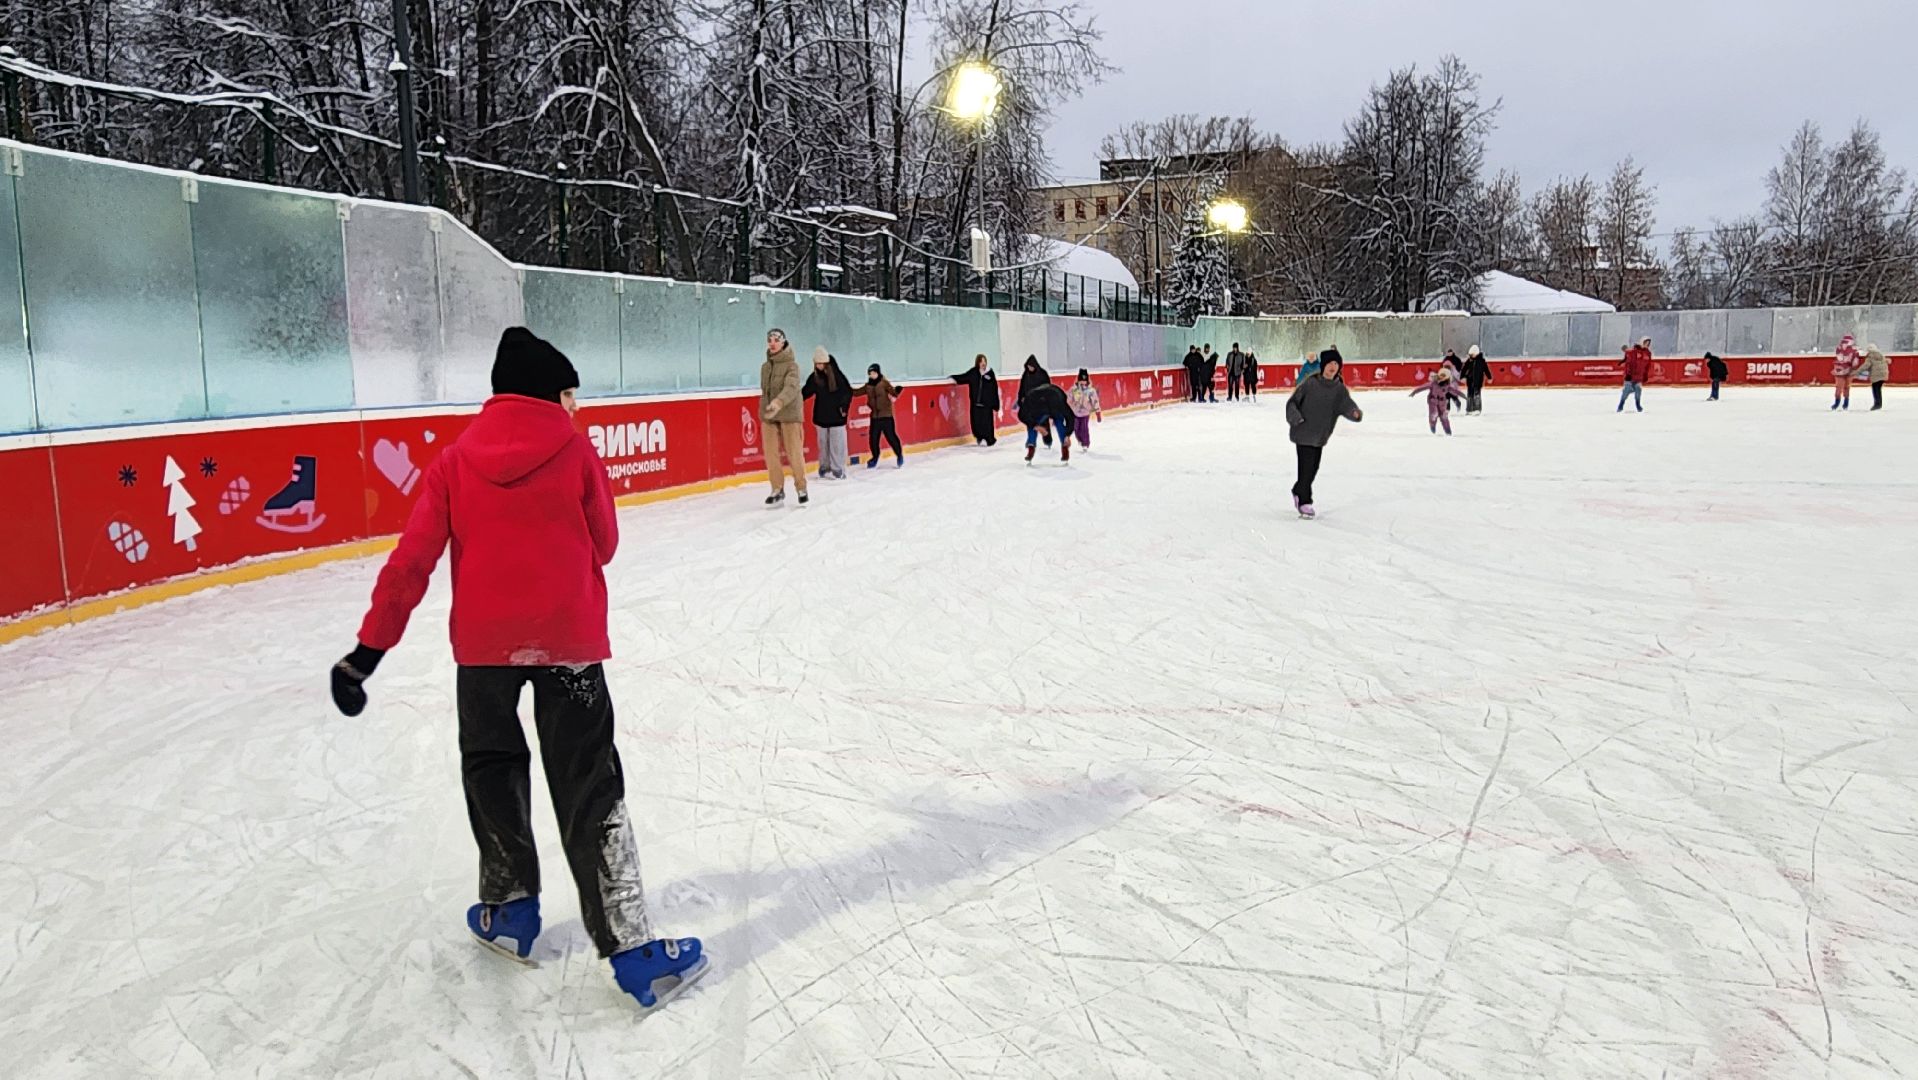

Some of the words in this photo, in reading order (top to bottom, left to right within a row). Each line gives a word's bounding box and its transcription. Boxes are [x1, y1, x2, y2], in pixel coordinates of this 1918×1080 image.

[1746, 362, 1792, 374] ЗИМА
[588, 419, 666, 458] ЗИМА
[605, 457, 666, 481] ОДМОСКОВЬЕ
